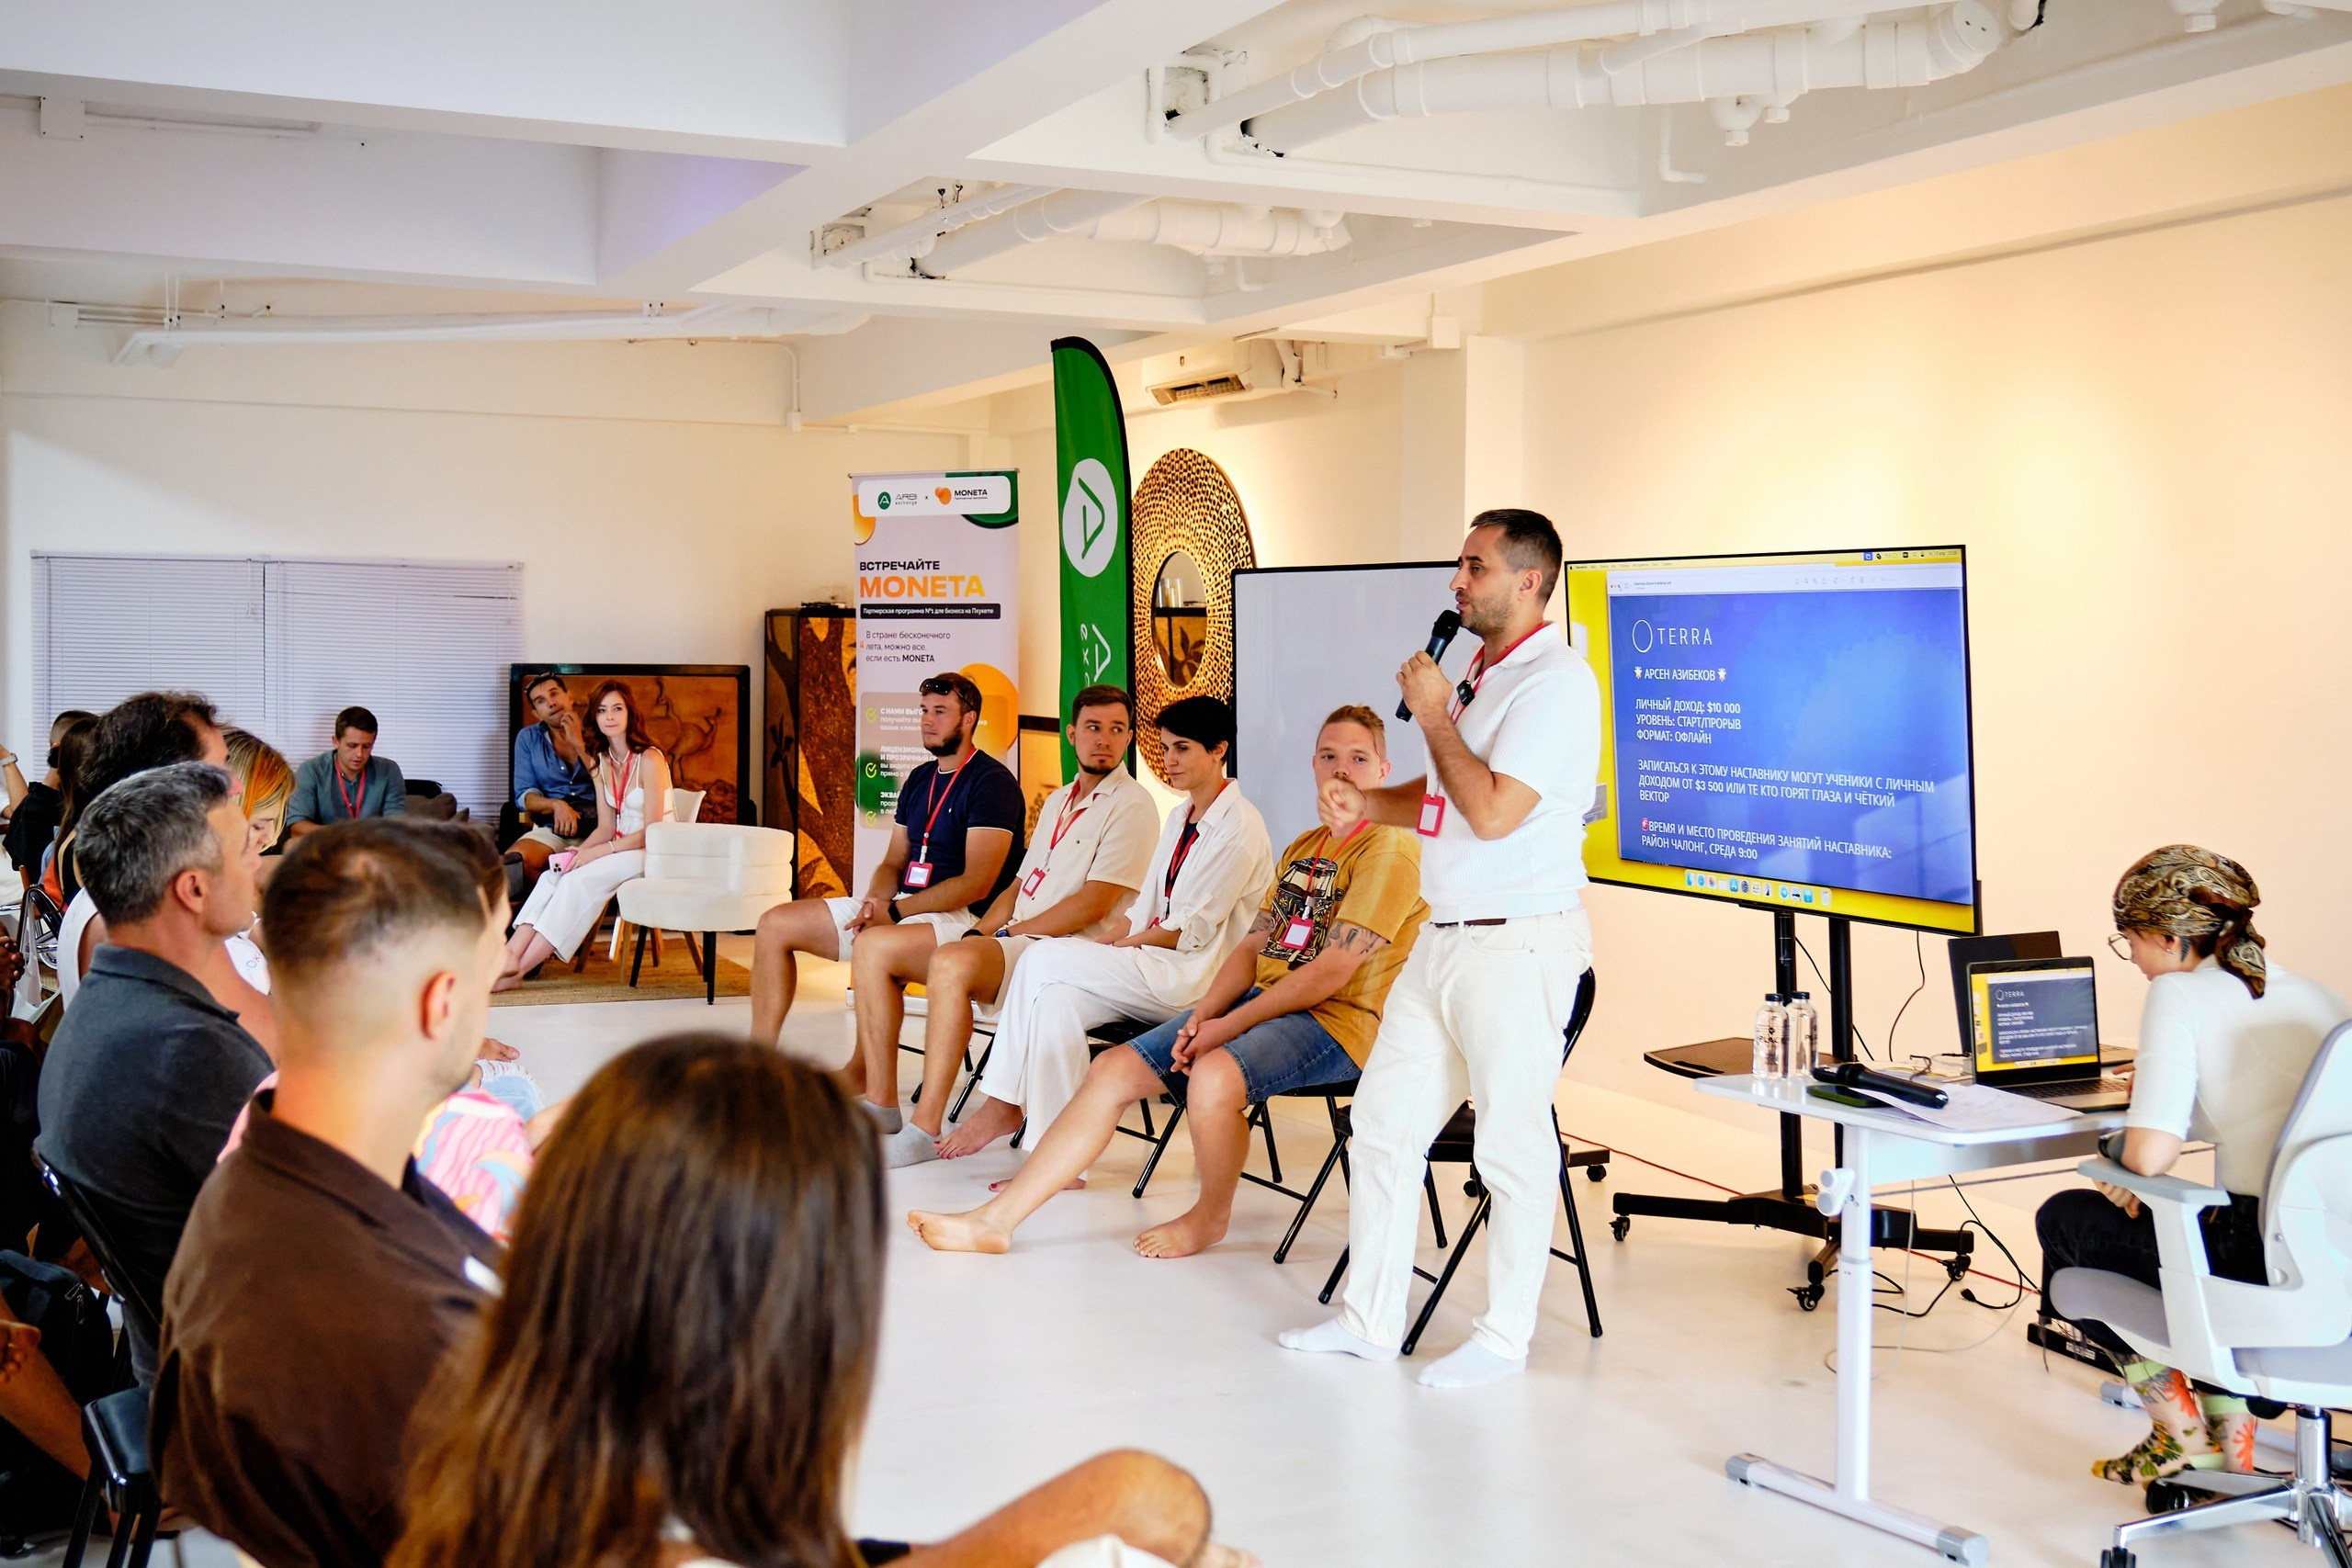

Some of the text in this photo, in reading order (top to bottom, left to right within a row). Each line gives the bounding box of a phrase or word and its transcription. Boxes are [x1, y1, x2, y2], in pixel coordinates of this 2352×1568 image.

[955, 489, 988, 497] MONETA
[859, 558, 940, 571] ВСТРЕЧАЙТЕ
[859, 575, 986, 598] MONETA
[863, 607, 894, 615] Партнерская
[971, 607, 994, 615] Пхукете
[872, 632, 898, 640] стране
[899, 630, 951, 639] бесконечного
[1657, 627, 1713, 645] TERRA
[1644, 668, 1716, 681] АРСЕН АЗИБЕКОВ
[1635, 697, 1741, 715] ЛИЧНЫЙ ДОХОД: $10 000
[1635, 714, 1741, 730] УРОВЕНЬ: СТАРТ/ПРОРЫВ
[1636, 729, 1712, 744] ФОРМАТ: ОФЛАЙН
[1638, 759, 1935, 794] ЗАПИСАТЬСЯ К ЭТОМУ НАСТАВНИКУ МОГУТ УЧЕНИКИ С ЛИЧНЫМ
[1638, 774, 1895, 807] ДОХОДОМ ОТ $3 500 ИЛИ ТЕ КТО ГОРЯТ ГЛАЗА И ЧЁТКИЙ
[1639, 790, 1669, 803] ВЕКТОР
[1641, 833, 1758, 860] РАЙОН ЧАЛОНГ, СРЕДА 9:00
[1648, 820, 1892, 859] ВРЕМЯ И МЕСТО ПРОВЕДЕНИЯ ЗАНЯТИЙ НАСТАВНИКА:
